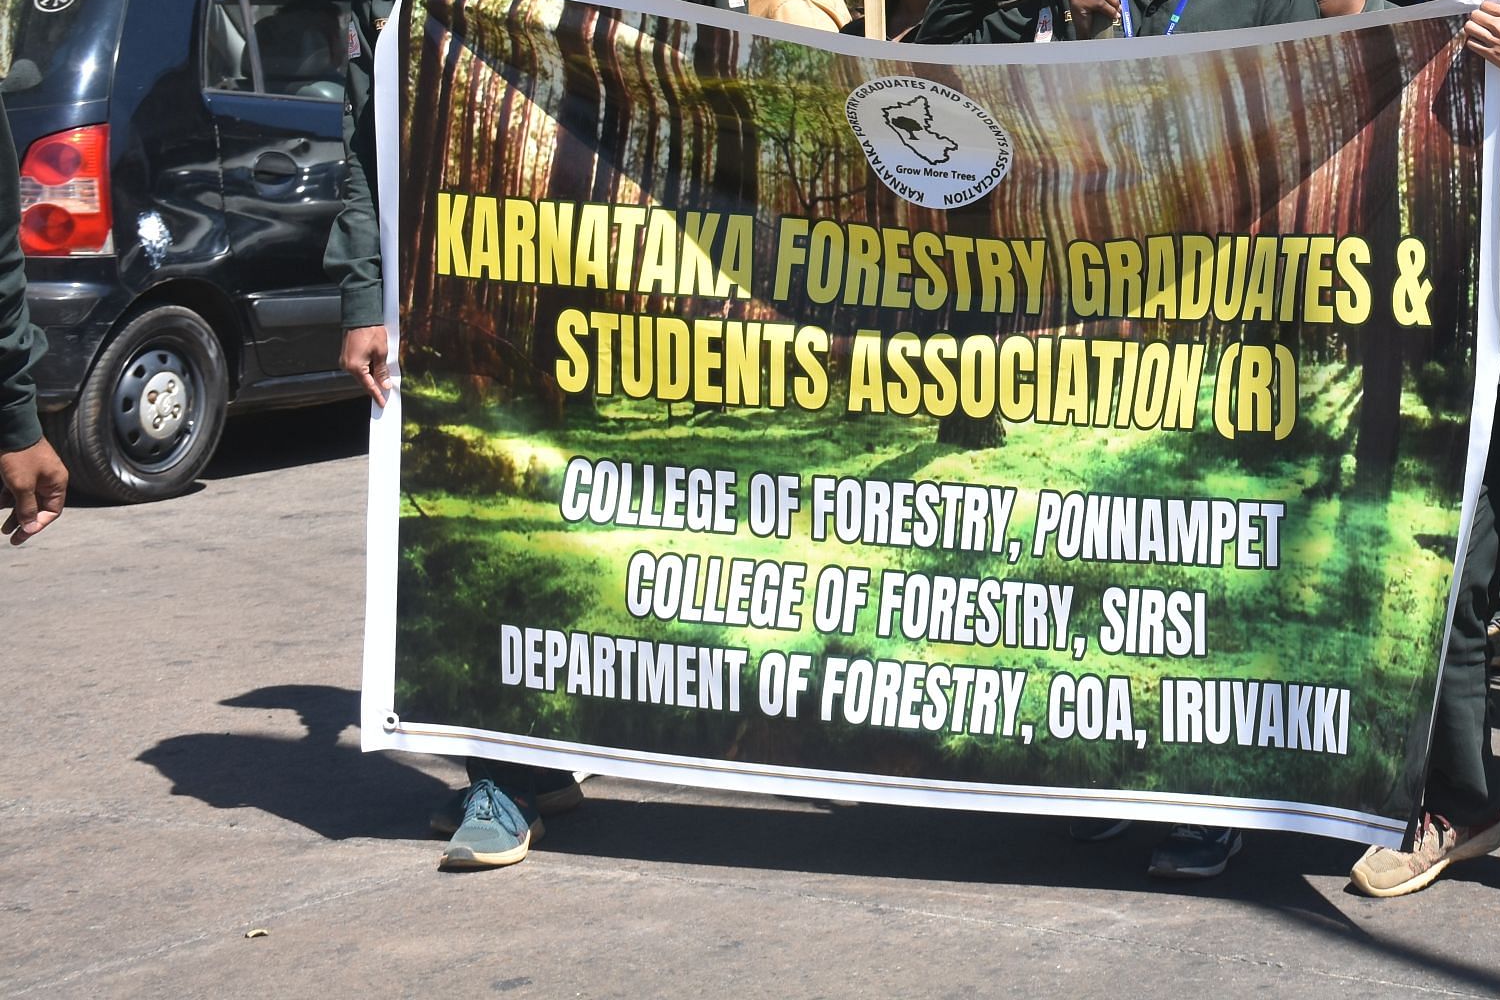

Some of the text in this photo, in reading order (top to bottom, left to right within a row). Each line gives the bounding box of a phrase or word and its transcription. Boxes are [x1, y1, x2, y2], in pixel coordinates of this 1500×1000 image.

[846, 79, 1009, 205] KARNATAKA FORESTRY GRADUATES AND STUDENTS ASSOCIATION
[896, 164, 976, 182] Grow More Trees
[437, 192, 1434, 327] KARNATAKA FORESTRY GRADUATES &
[555, 308, 1297, 441] STUDENTS ASSOCIATION (R)
[561, 457, 1286, 569] COLLEGE OF FORESTRY, PONNAMPET
[627, 552, 1207, 659] COLLEGE OF FORESTRY, SIRSI
[501, 624, 1351, 755] DEPARTMENT OF FORESTRY, COA, IRUVAKKI
